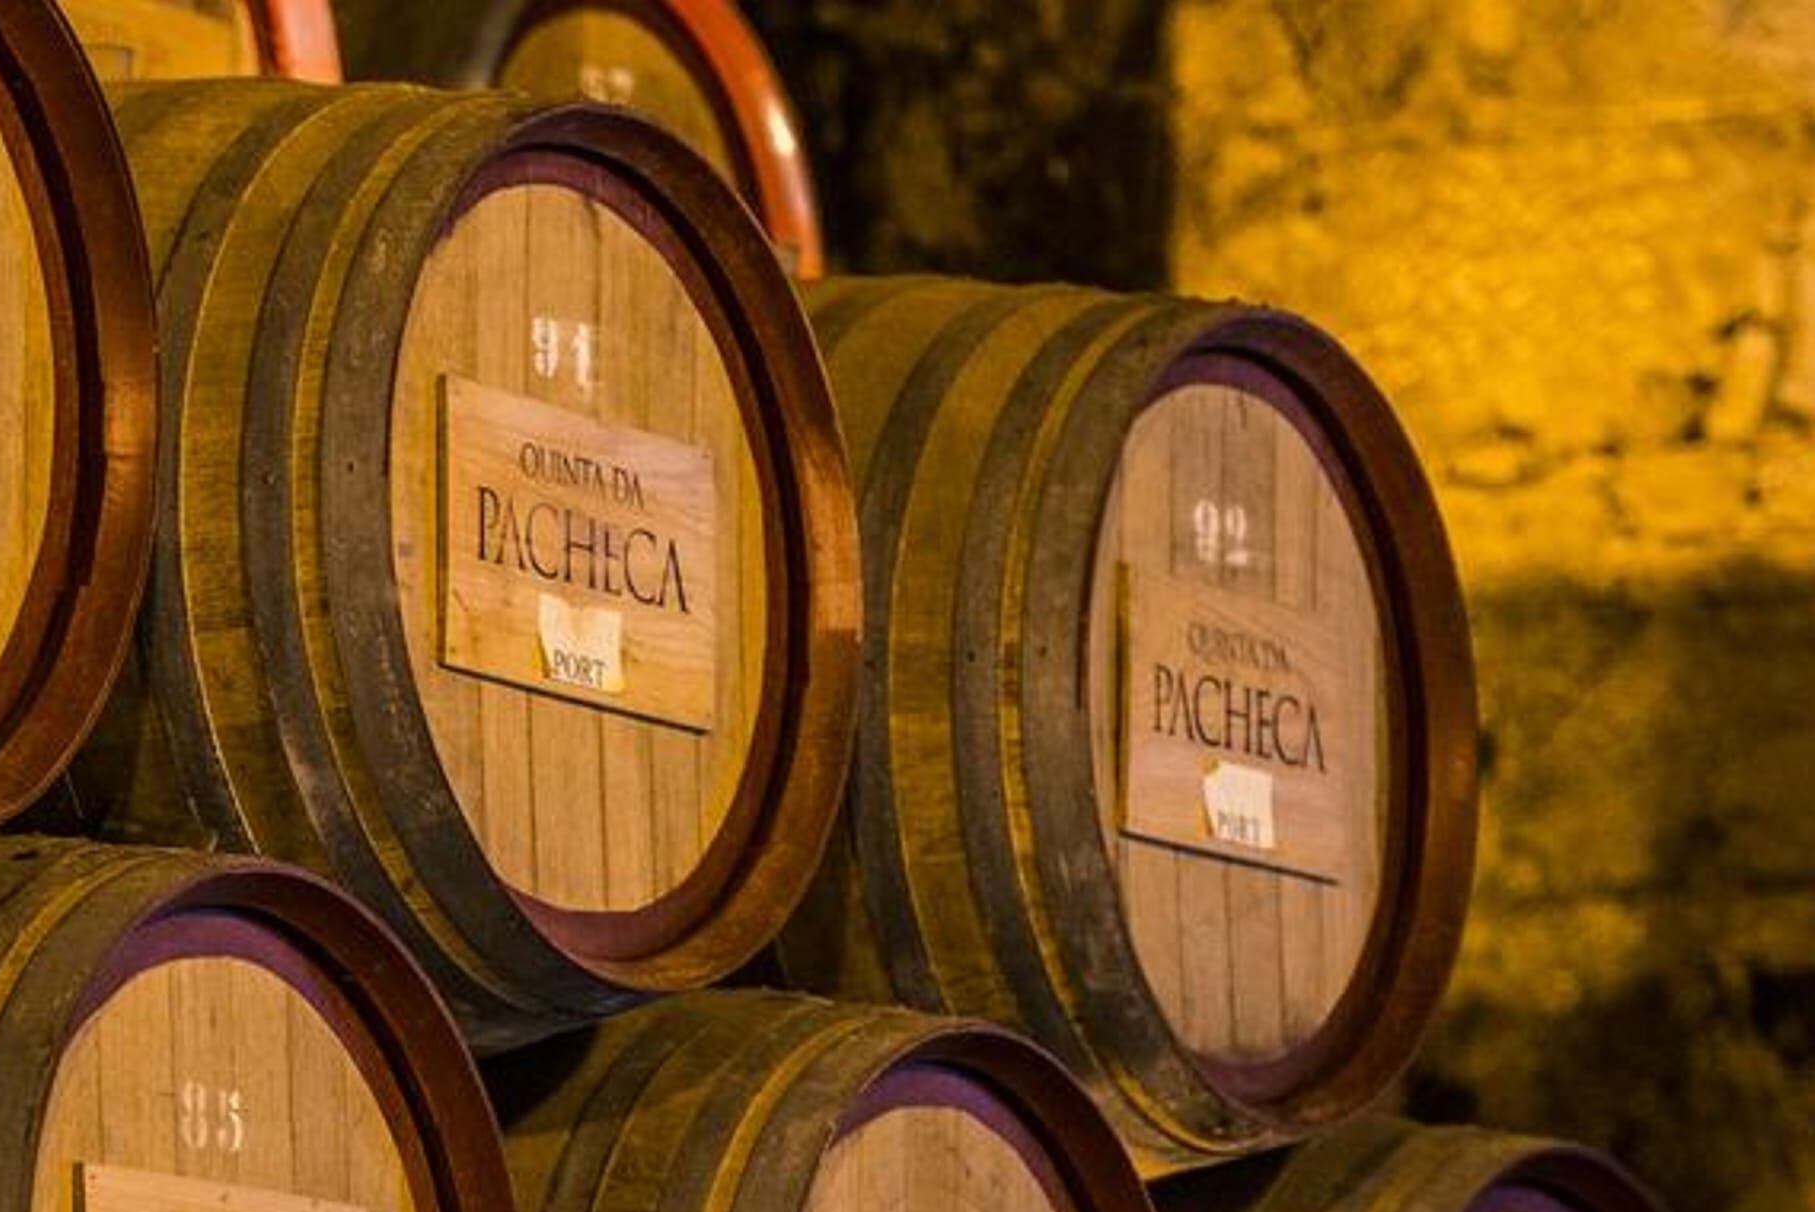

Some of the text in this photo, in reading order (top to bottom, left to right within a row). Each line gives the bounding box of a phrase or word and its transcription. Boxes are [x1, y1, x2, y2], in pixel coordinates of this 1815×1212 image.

[519, 441, 645, 509] QUINTA DA
[477, 486, 691, 614] PACHECA
[552, 649, 606, 687] PORT
[1152, 662, 1327, 774] PACHECA
